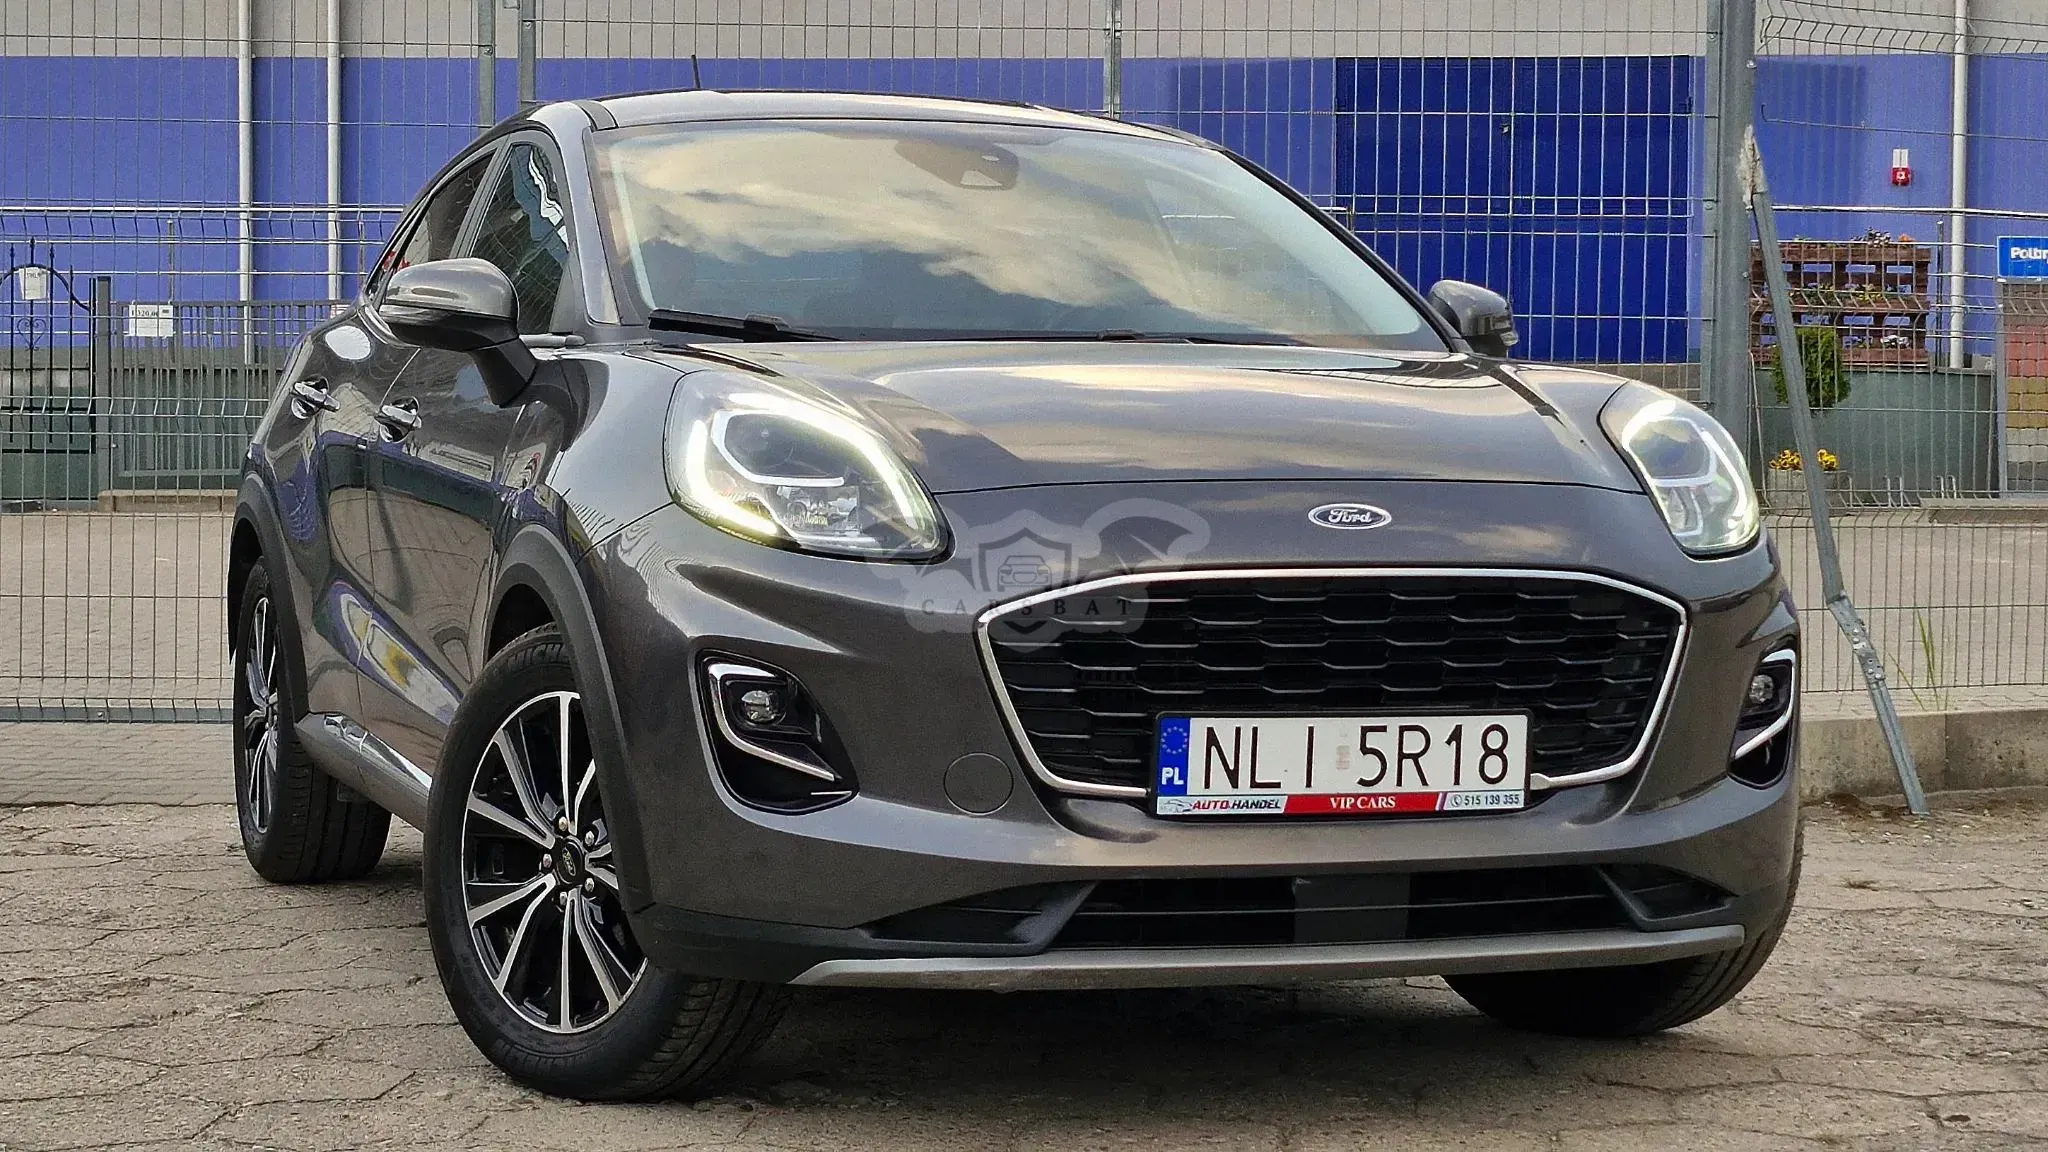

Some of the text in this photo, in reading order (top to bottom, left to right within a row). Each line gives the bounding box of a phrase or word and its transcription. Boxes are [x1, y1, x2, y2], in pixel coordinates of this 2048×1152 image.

[1328, 508, 1373, 523] Ford
[1357, 724, 1509, 788] 5R18
[1161, 767, 1185, 786] PL
[1330, 796, 1396, 809] VIP CARS
[1463, 793, 1520, 806] 515 139 355
